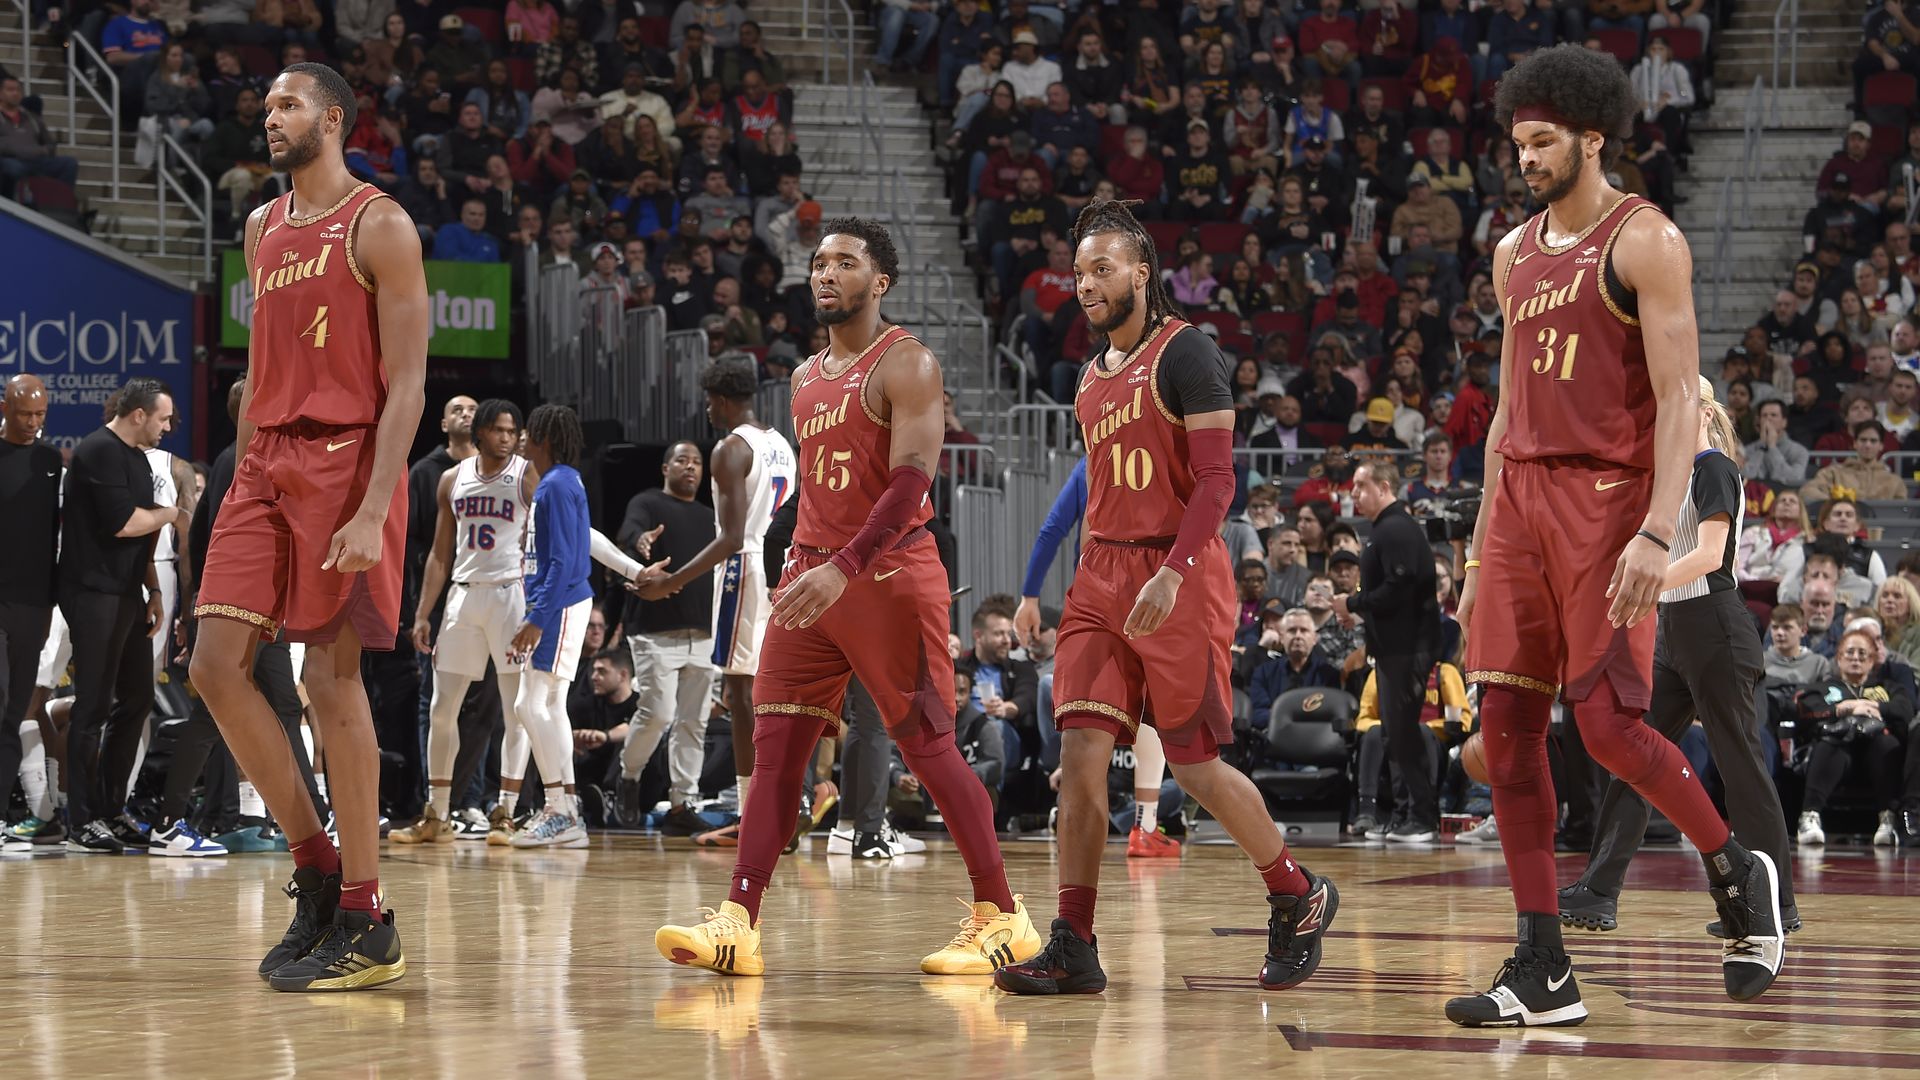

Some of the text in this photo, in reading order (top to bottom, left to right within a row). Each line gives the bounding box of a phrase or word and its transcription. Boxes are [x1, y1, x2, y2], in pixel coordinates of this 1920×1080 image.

[320, 232, 345, 240] CLIFFS
[281, 250, 299, 265] The
[254, 243, 333, 302] Land
[1505, 267, 1587, 328] Land
[1534, 279, 1554, 294] The
[299, 305, 332, 349] 4
[1531, 326, 1581, 382] 31
[57, 374, 119, 389] COLLEGE
[843, 382, 861, 390] CLIFFS
[1127, 375, 1150, 385] CLIFFS
[813, 401, 829, 415] The
[1100, 401, 1116, 417] The
[808, 444, 853, 492] 45
[1107, 442, 1154, 491] 10
[768, 475, 789, 519] 7
[467, 522, 497, 551] 16
